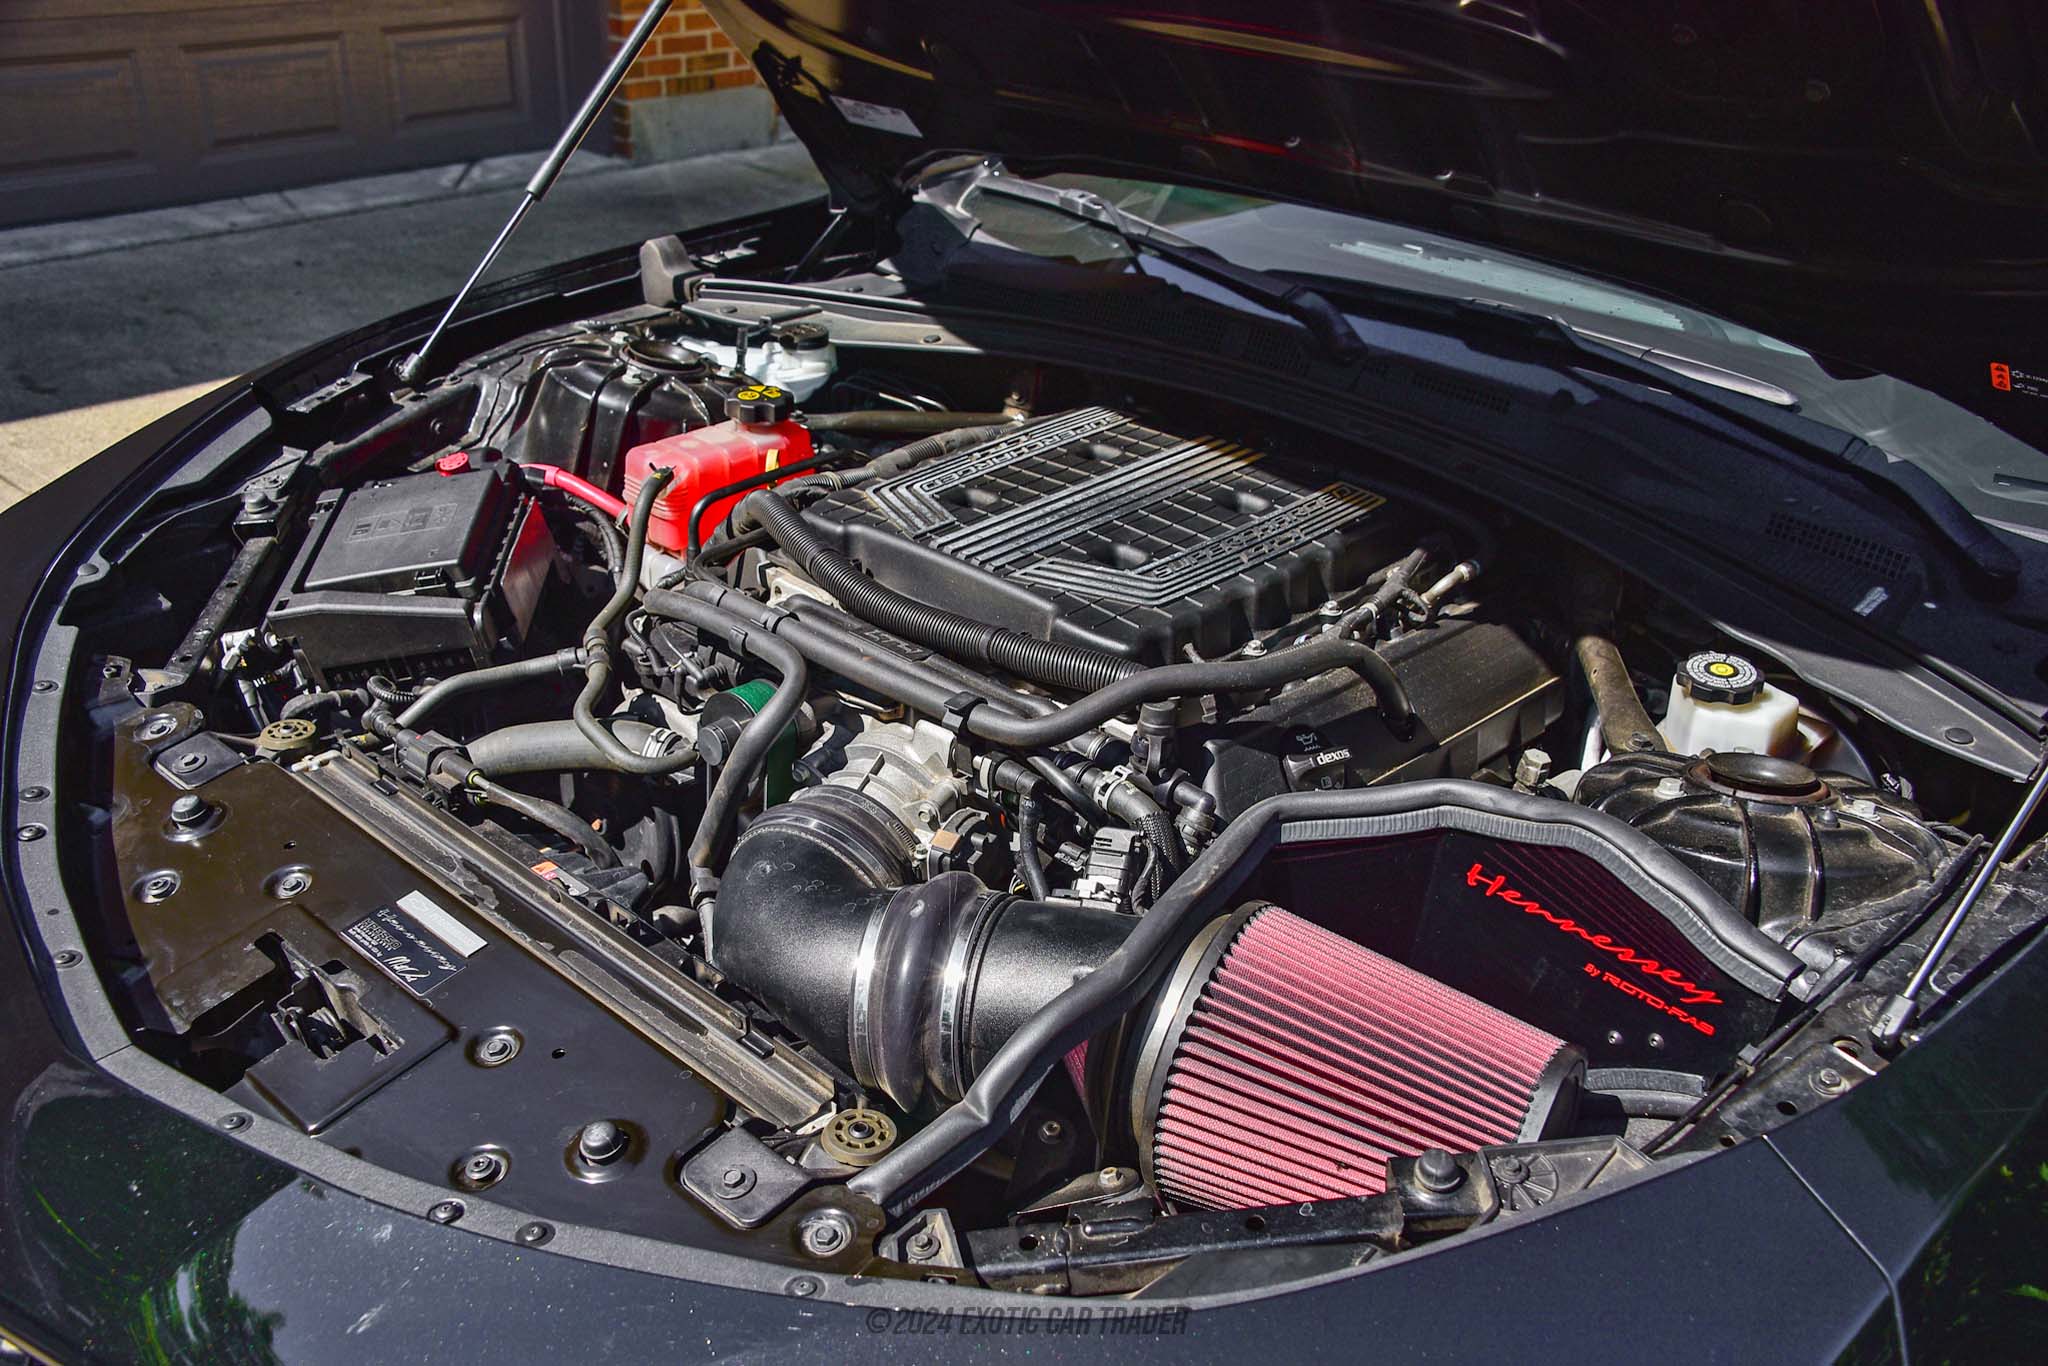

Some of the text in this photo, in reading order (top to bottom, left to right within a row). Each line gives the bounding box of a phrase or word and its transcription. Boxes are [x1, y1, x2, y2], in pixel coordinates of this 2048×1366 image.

[921, 414, 1125, 492] SUPERCHARGED
[1153, 487, 1348, 578] SUPERCHARGED
[1316, 749, 1351, 766] dexos
[1467, 863, 1724, 1004] Hennessey
[1583, 962, 1601, 978] By
